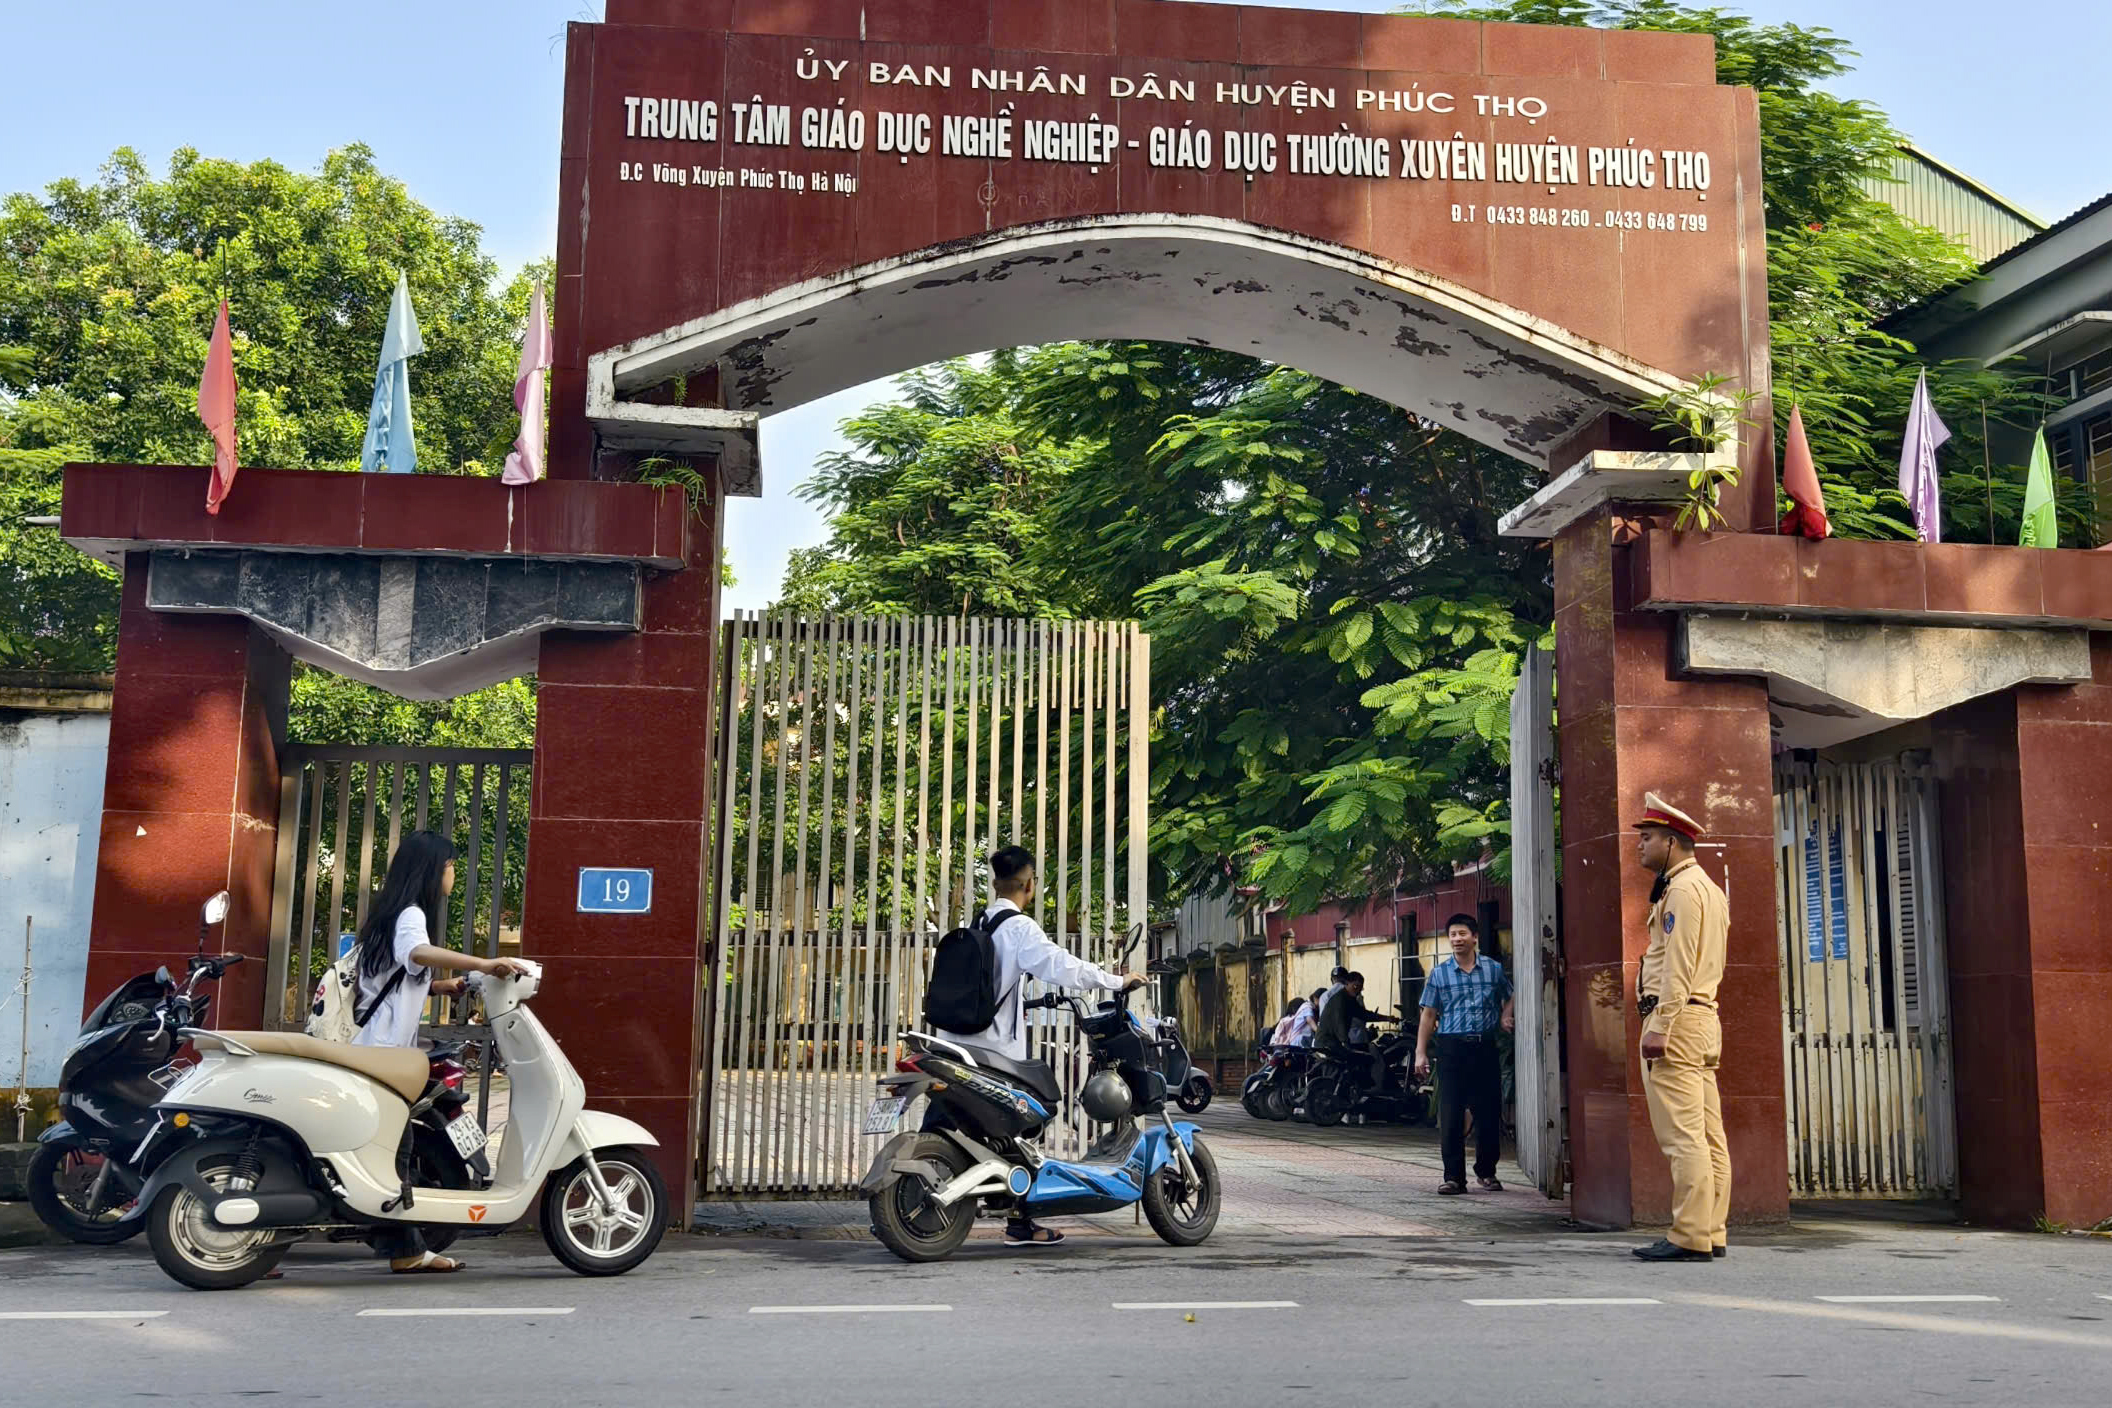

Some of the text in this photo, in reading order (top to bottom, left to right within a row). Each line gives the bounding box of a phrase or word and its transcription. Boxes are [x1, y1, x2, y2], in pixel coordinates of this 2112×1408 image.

[796, 48, 1548, 125] ỦY BAN NHÂN DÂN HUYỆN PHÚC THỌ
[624, 94, 1711, 201] TRUNG TÂM GIÁO DỤC NGHỀ NGHIỆP - GIÁO DỤC THƯỜNG XUYÊN HUYỆN PHÚC THỌ
[620, 161, 643, 181] Đ.C
[652, 162, 687, 186] Võng
[692, 165, 735, 188] Xuyên
[740, 167, 774, 189] Phúc
[778, 170, 805, 195] Thọ
[811, 170, 828, 191] Hà
[1451, 203, 1476, 223] Đ.T
[1486, 205, 1525, 225] 0433
[1529, 207, 1558, 226] 848
[1561, 208, 1590, 227] 260
[1605, 210, 1642, 230] 0433
[1646, 211, 1676, 231] 648
[1678, 213, 1708, 232] 799
[602, 878, 630, 902] 19
